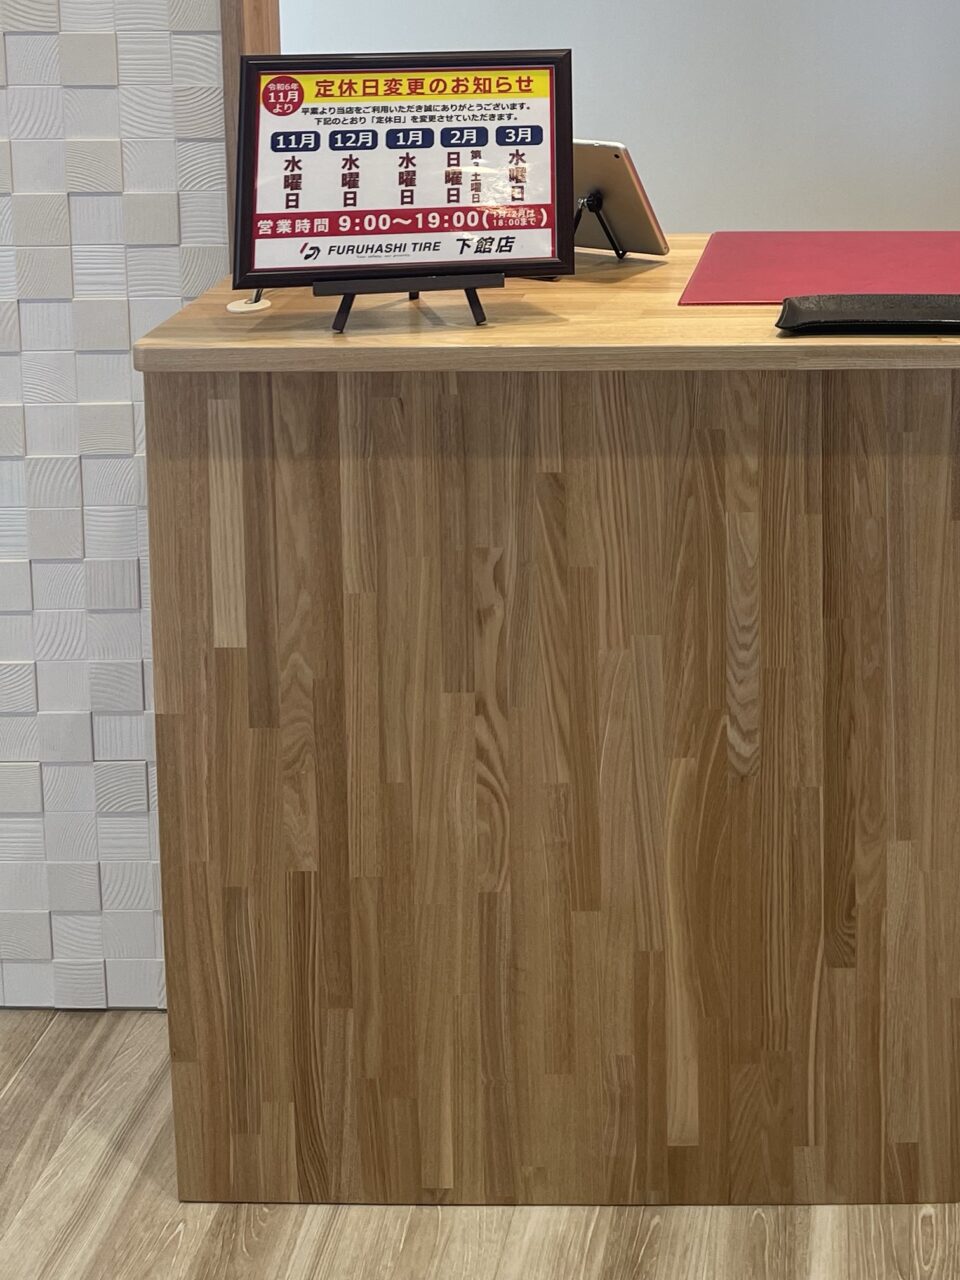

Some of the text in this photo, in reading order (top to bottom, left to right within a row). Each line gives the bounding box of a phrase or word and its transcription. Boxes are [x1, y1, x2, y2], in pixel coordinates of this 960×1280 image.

[314, 75, 534, 98] 定休日変更のお知らせ
[268, 91, 299, 103] 11月
[272, 103, 293, 113] より
[276, 133, 316, 149] 11月
[334, 132, 373, 147] 12月
[396, 131, 423, 146] 1月
[450, 129, 478, 144] 2月
[504, 127, 532, 143] 3月
[283, 155, 302, 209] 水曜日
[341, 154, 360, 207] 水曜日
[398, 152, 417, 205] 水曜日
[444, 151, 463, 204] 日曜日
[257, 218, 330, 235] 営業時間
[328, 235, 516, 255] FURUHASHI TIRE 下館店
